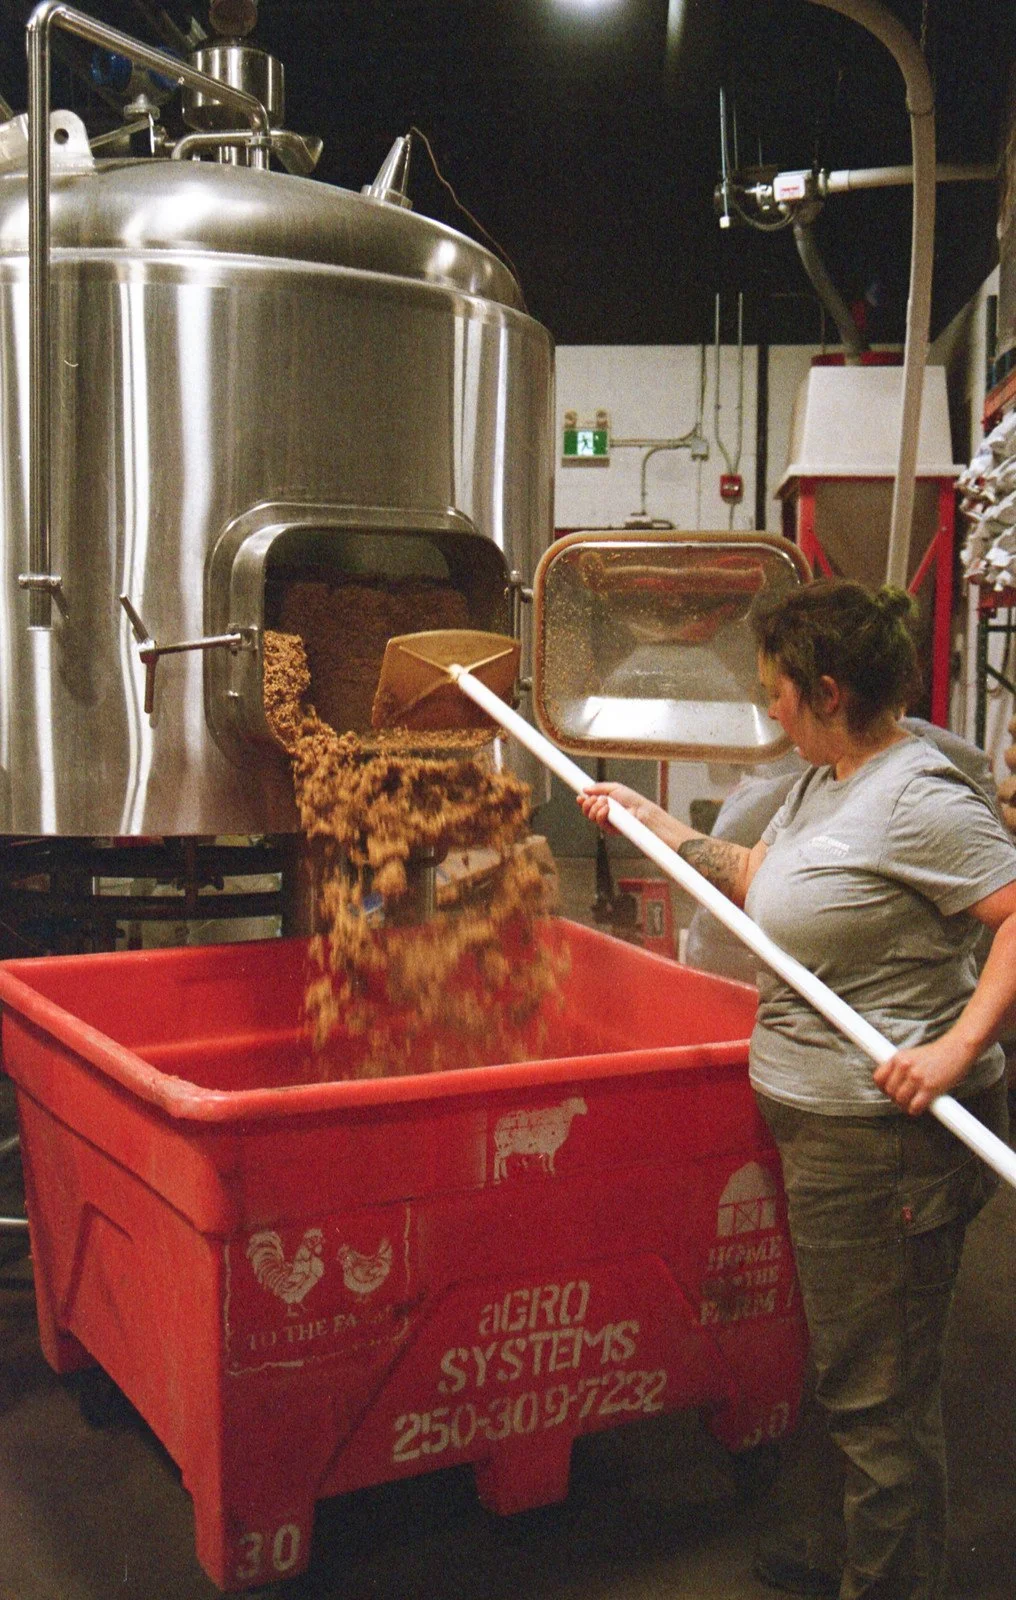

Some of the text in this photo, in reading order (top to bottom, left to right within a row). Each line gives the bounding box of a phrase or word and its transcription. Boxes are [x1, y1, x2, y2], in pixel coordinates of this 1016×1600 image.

[284, 1318, 330, 1344] THE
[437, 1319, 641, 1394] SYSTEMS
[392, 1368, 668, 1462] 250-309-7232
[235, 1523, 301, 1579] 30
